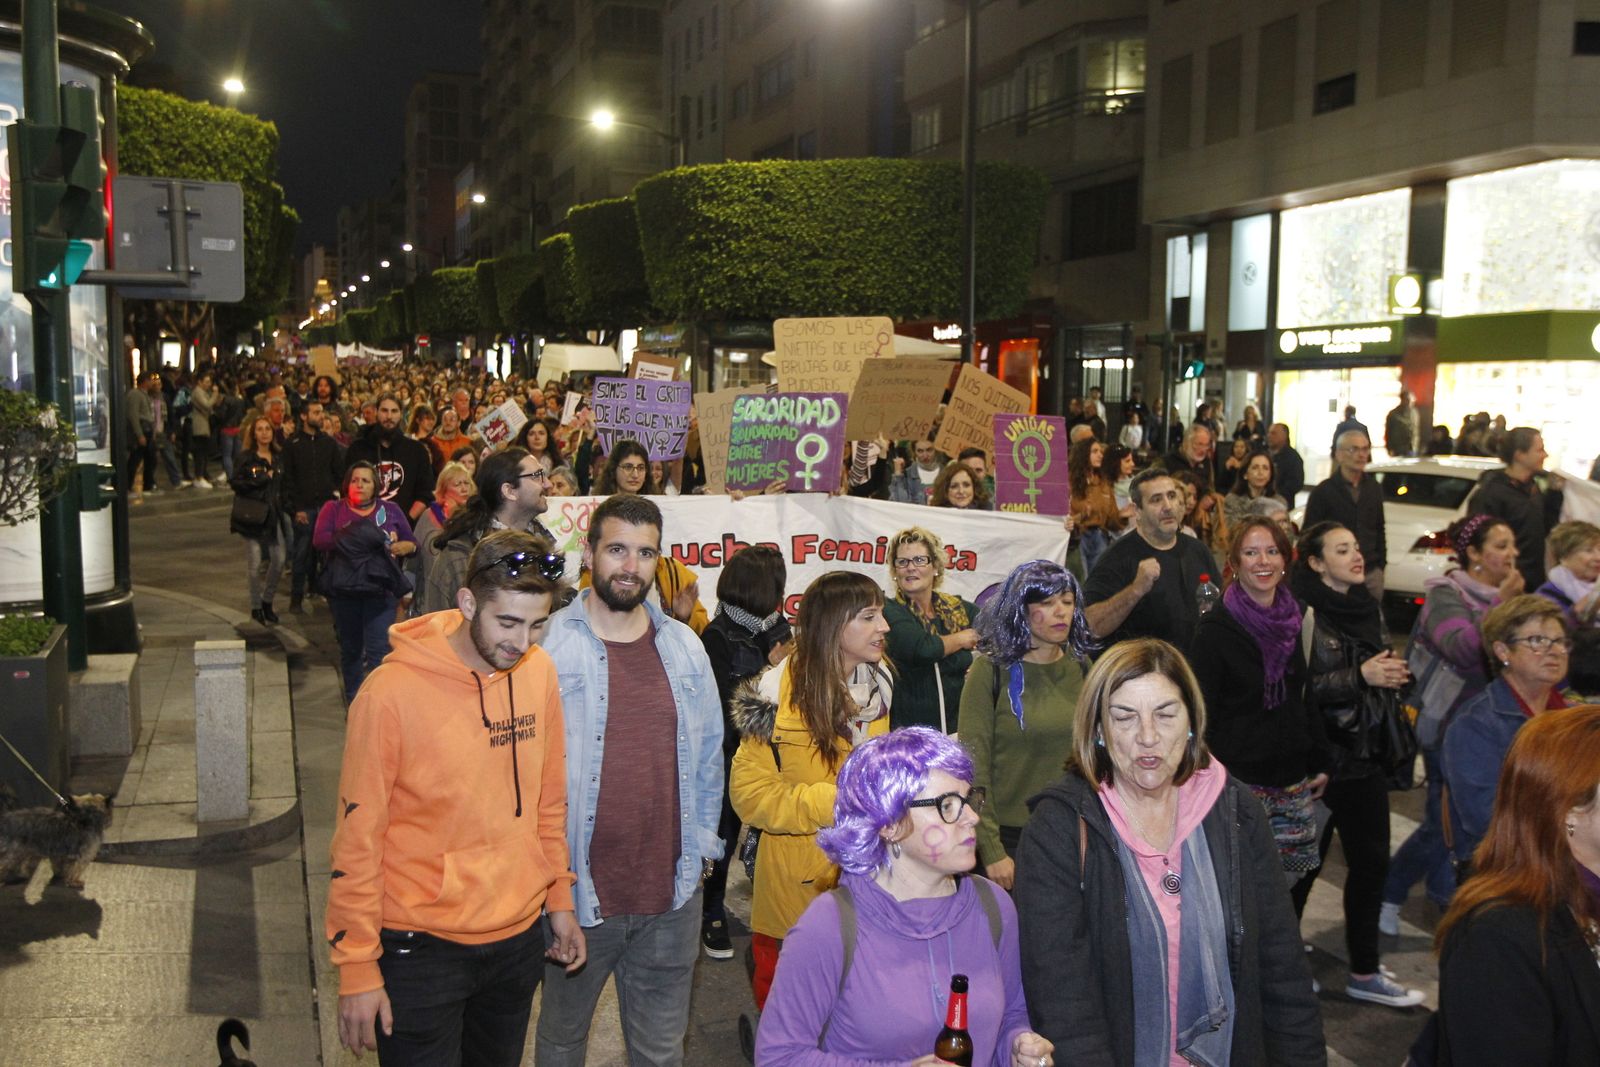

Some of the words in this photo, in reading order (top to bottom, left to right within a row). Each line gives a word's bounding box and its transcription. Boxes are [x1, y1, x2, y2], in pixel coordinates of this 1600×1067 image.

[782, 320, 836, 337] SOMOS
[846, 318, 875, 336] LAS
[783, 341, 826, 357] NIETAS
[833, 341, 848, 355] DE
[854, 341, 875, 356] LAS
[781, 360, 828, 375] BRUJAS
[833, 359, 853, 373] QUE
[596, 381, 628, 400] SOMOS
[635, 384, 648, 401] EL
[656, 384, 690, 404] GRITO
[595, 403, 611, 424] DE
[615, 404, 631, 425] LAS
[635, 411, 659, 429] QUE
[663, 414, 674, 429] YA
[732, 396, 841, 428] SORORIDAD
[1003, 416, 1056, 442] UNIDAS
[725, 460, 791, 485] MUJERES
[489, 713, 536, 735] HALLOWEEN
[489, 726, 536, 749] NIGHTMARE
